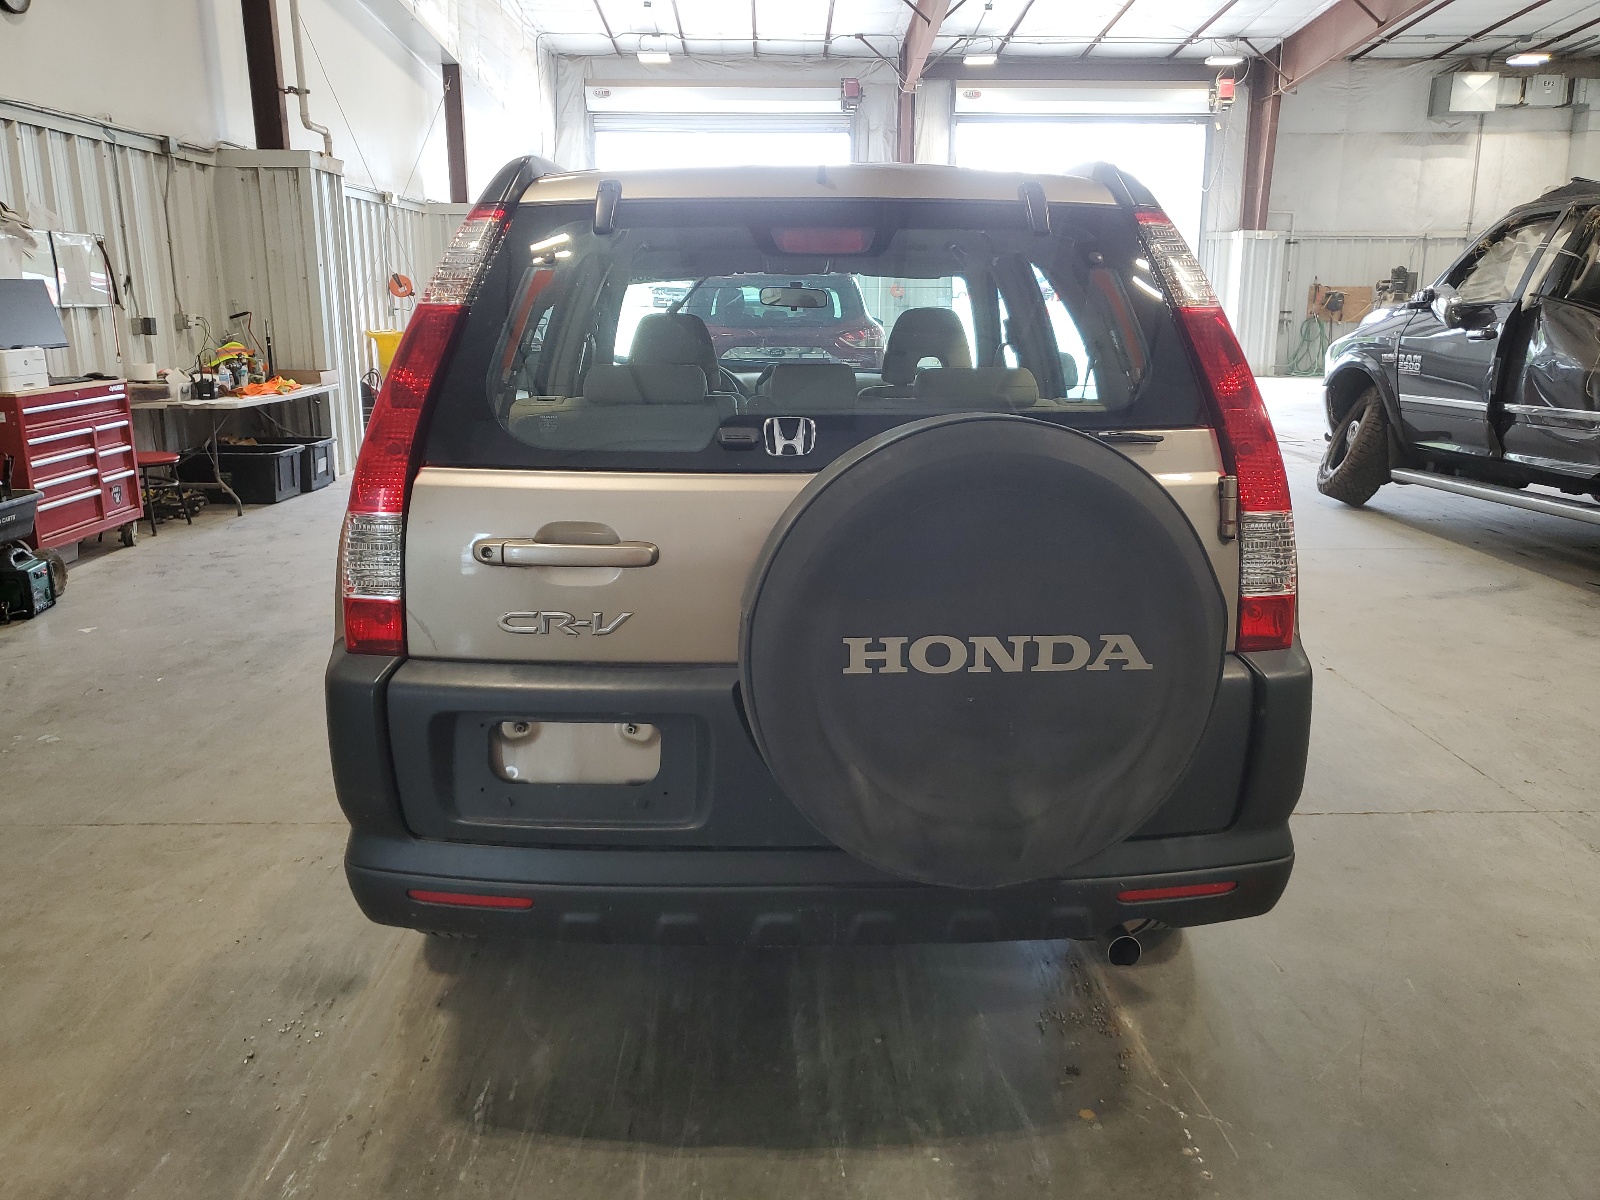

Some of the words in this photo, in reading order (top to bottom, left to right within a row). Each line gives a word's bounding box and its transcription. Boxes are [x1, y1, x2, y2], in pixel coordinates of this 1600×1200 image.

[1398, 354, 1422, 362] RAM
[1398, 362, 1421, 370] 2500
[497, 610, 634, 636] CR-V
[842, 634, 1154, 675] HONDA
